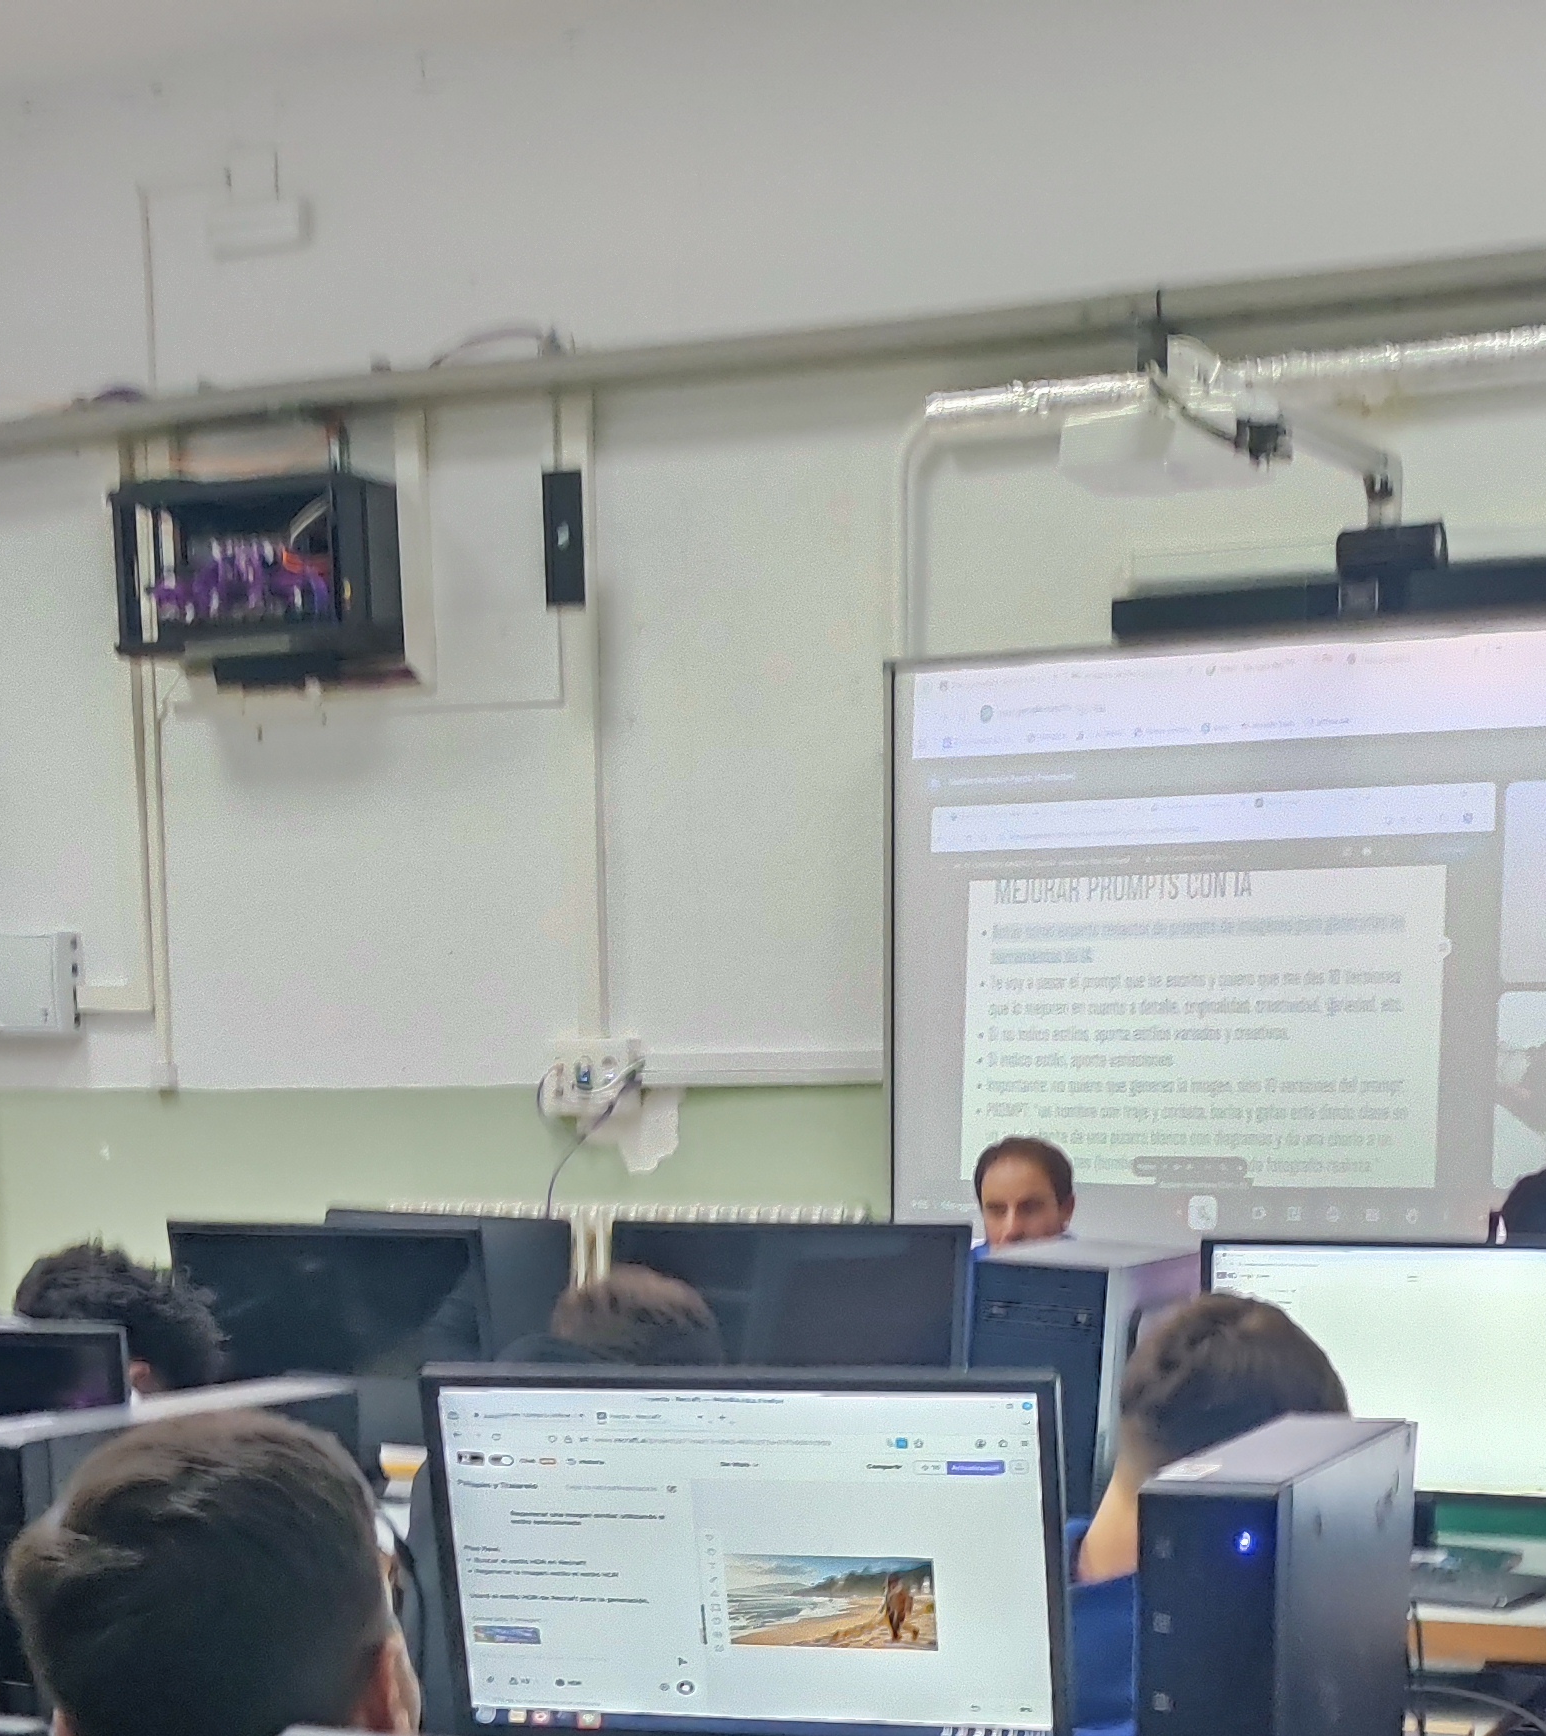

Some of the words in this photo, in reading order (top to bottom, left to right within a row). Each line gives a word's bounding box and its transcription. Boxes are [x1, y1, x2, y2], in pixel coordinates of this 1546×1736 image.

[993, 877, 1079, 904] MEJORAR
[1086, 874, 1179, 901] PROMPTS
[1186, 872, 1225, 898] CON
[1234, 871, 1252, 897] IA
